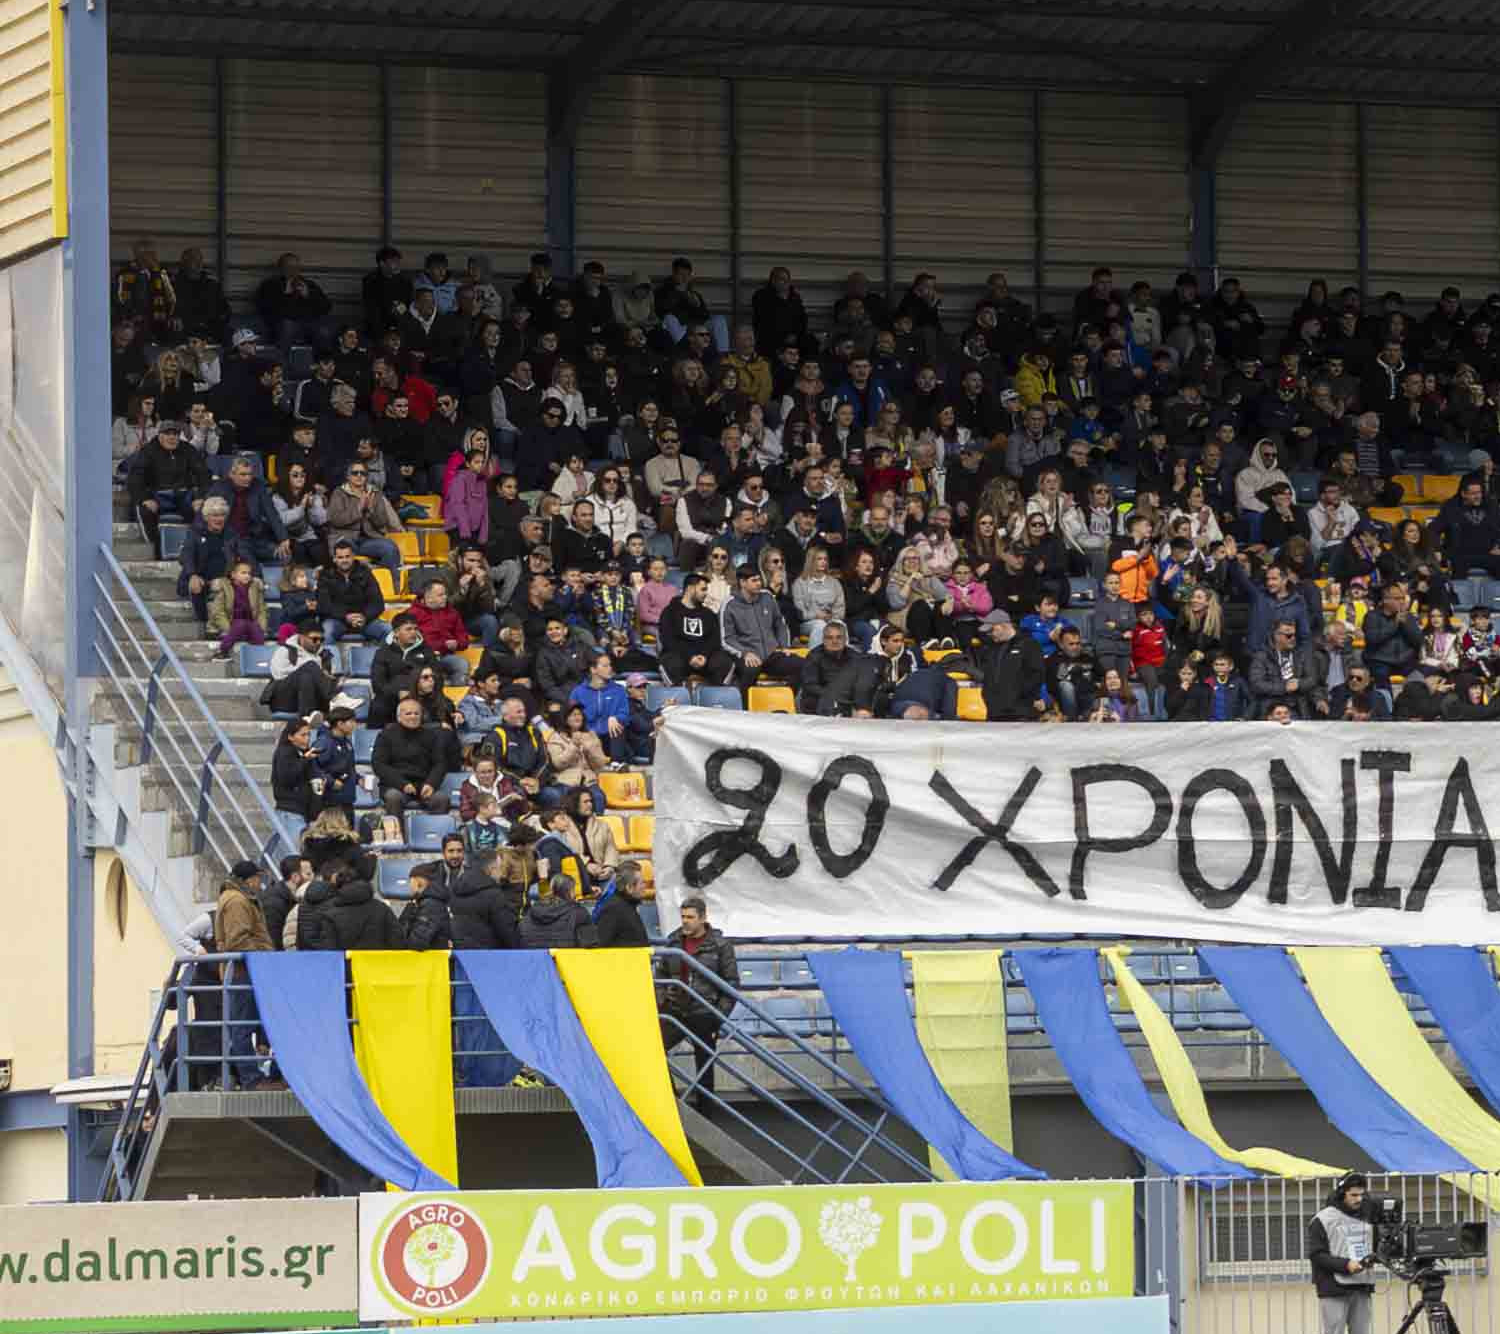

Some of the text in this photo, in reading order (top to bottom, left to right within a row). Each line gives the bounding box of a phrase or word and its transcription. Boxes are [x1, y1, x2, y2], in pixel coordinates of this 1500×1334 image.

[682, 746, 891, 889] 20
[408, 1206, 465, 1230] AGRO
[511, 1198, 1106, 1283] AGRO POLI
[412, 1286, 457, 1307] POLI
